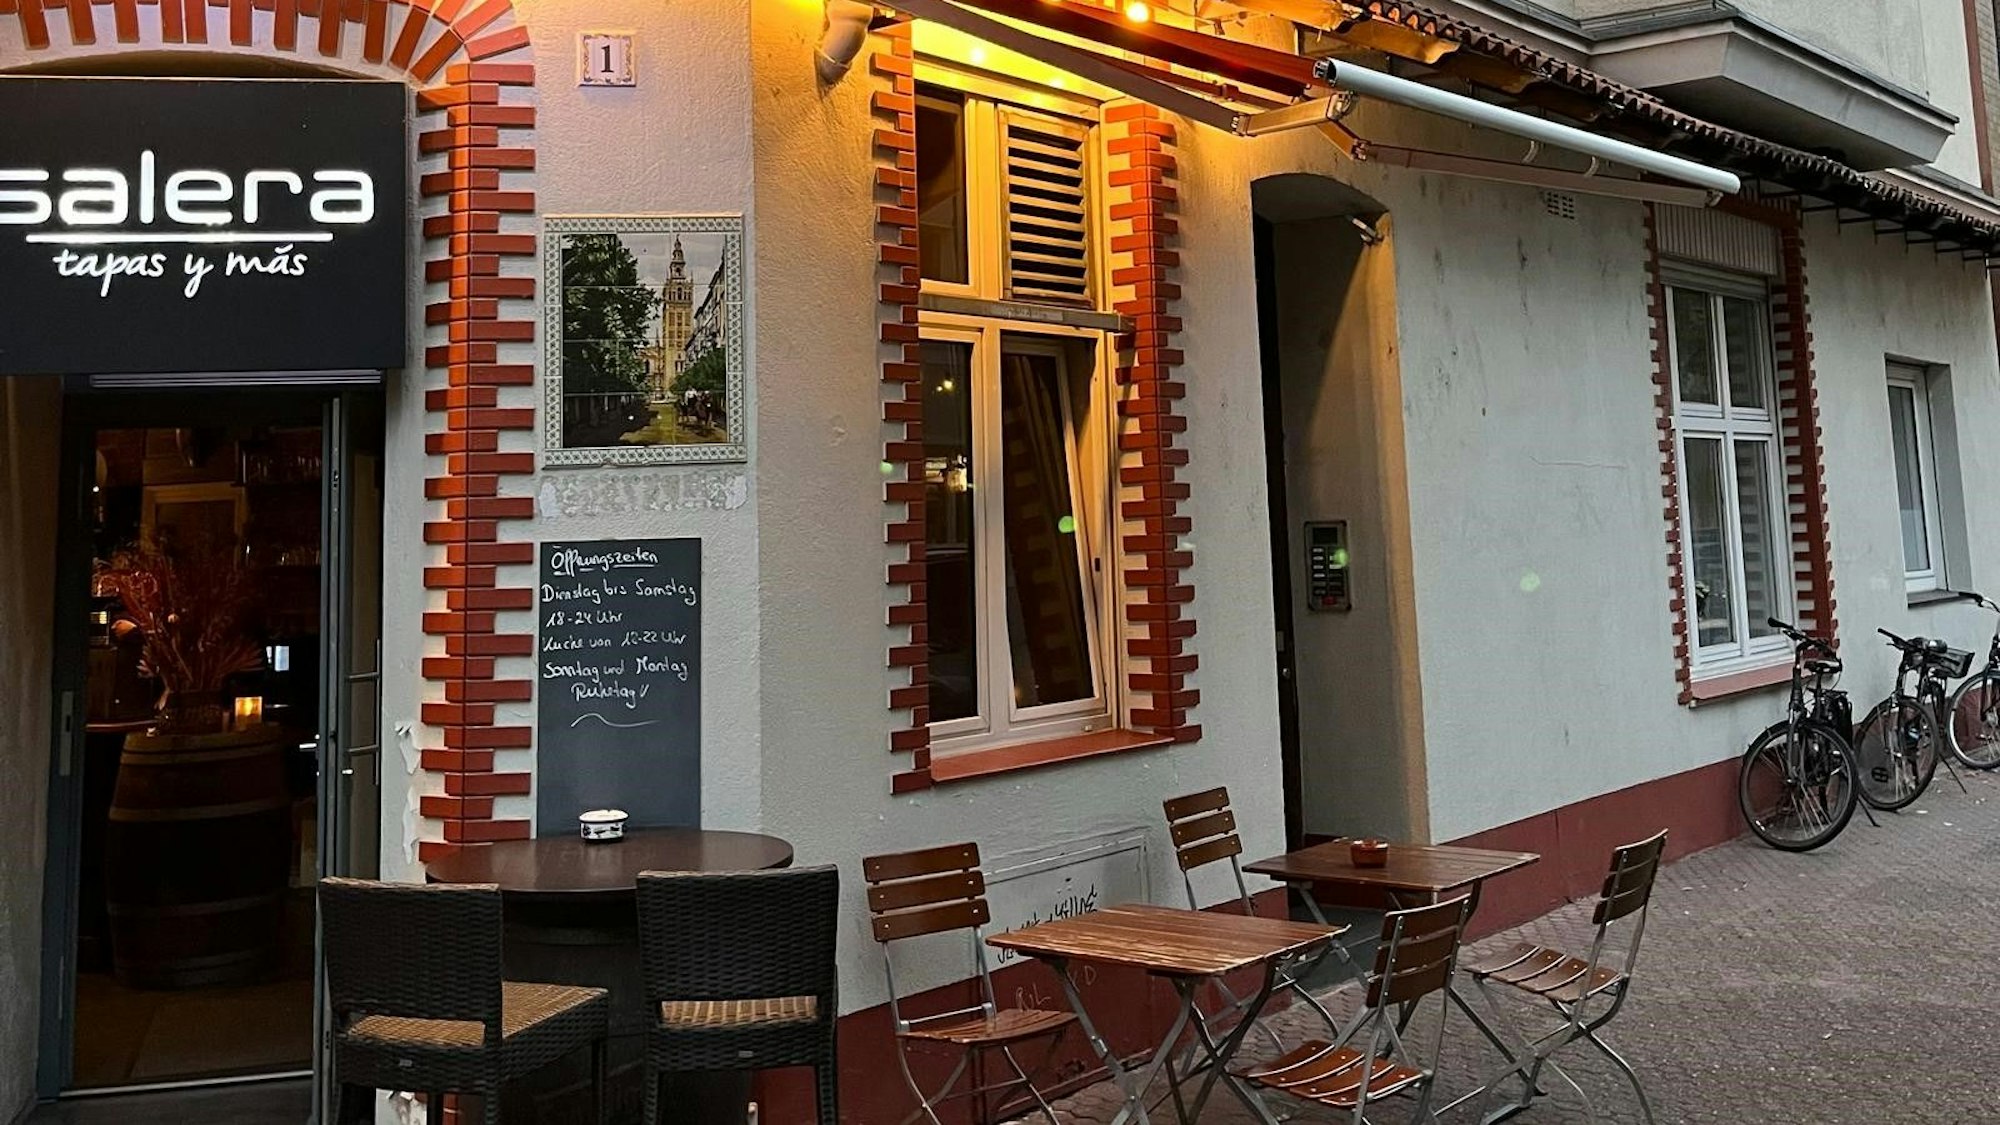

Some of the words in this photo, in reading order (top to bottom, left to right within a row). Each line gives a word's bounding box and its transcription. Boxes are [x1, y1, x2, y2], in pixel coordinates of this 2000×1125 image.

[600, 44, 615, 73] 1
[0, 149, 375, 225] salera
[52, 247, 166, 298] tapas
[183, 252, 214, 299] y
[225, 242, 309, 277] más
[602, 578, 627, 596] bis
[635, 577, 697, 606] Samstag
[596, 609, 624, 625] Uhr
[588, 638, 612, 648] von
[661, 629, 687, 646] Uhr
[542, 660, 600, 683] Sonntag
[602, 659, 625, 675] und
[635, 655, 689, 681] Montag
